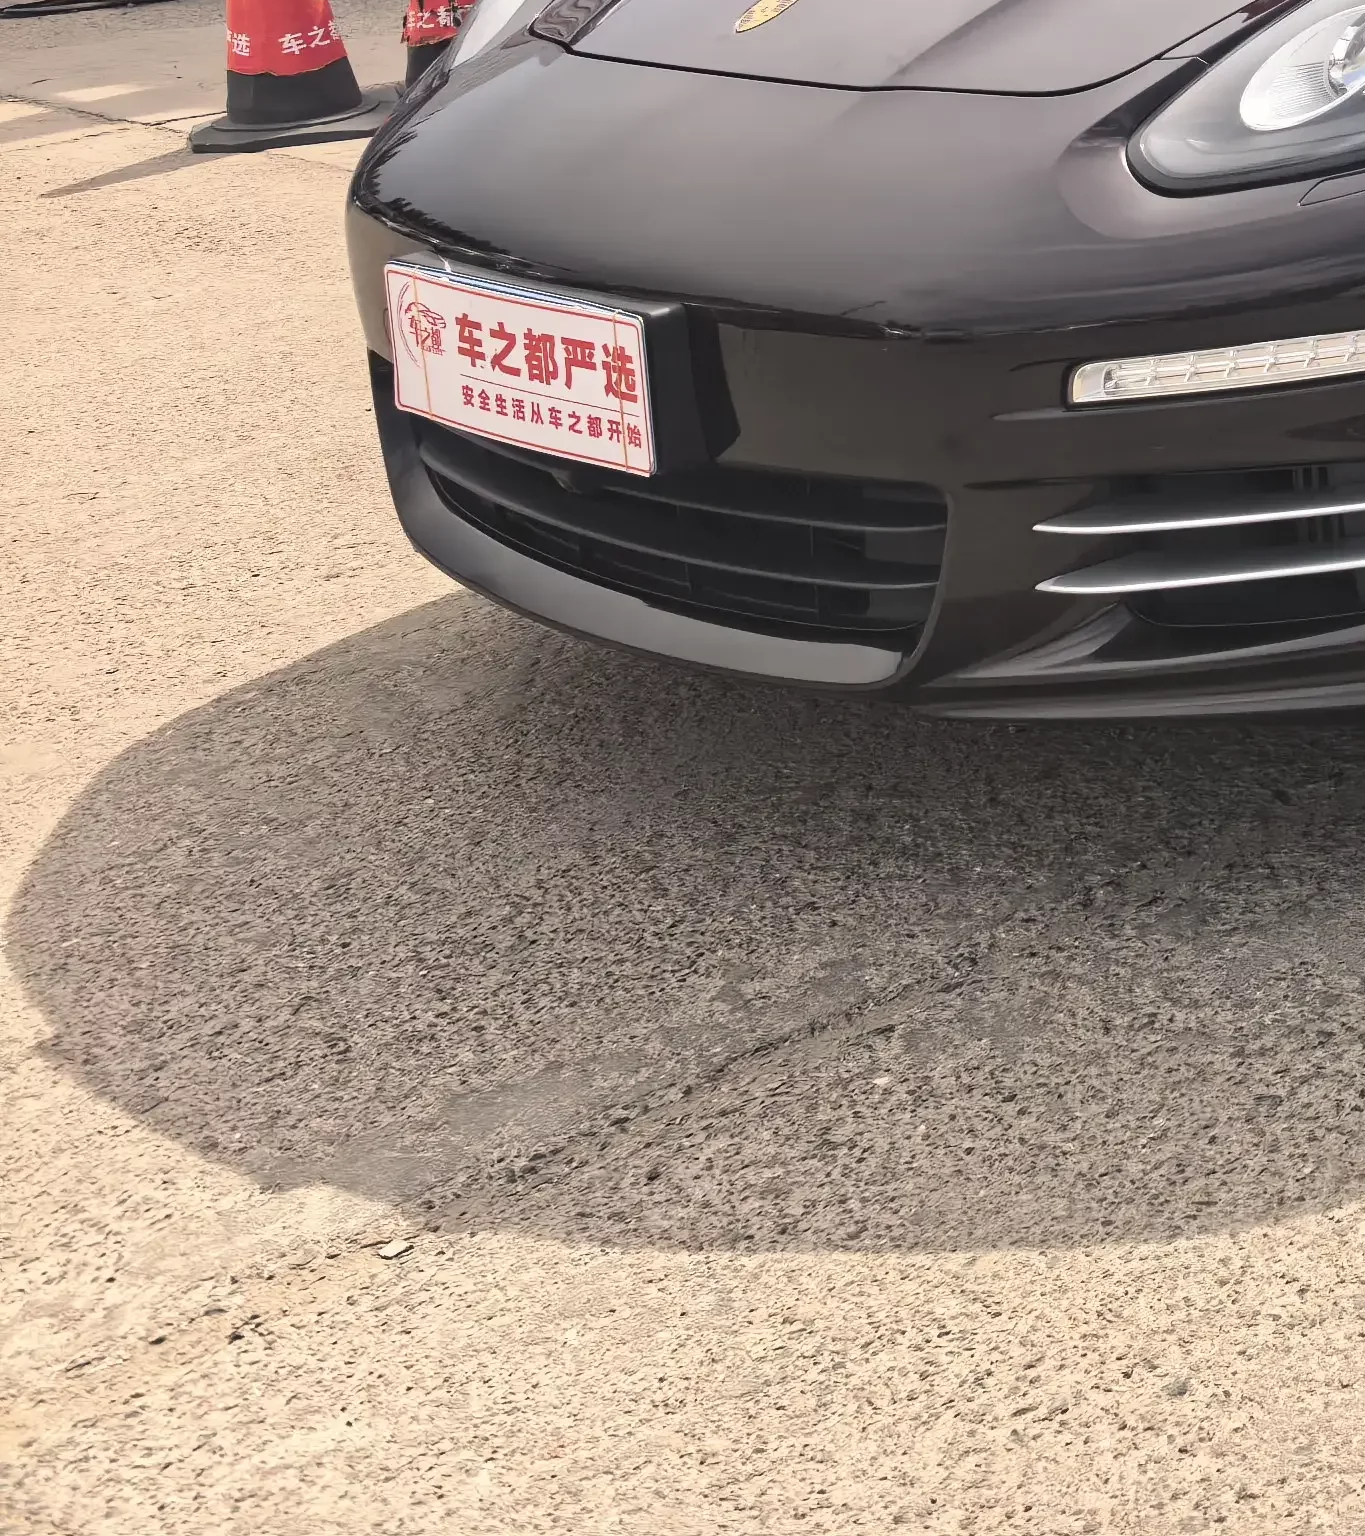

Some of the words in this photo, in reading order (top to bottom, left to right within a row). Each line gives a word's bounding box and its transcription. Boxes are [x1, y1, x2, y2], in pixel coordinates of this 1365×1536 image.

[455, 312, 638, 404] 车之都严选
[461, 384, 643, 449] 安全生活从车之都开始
